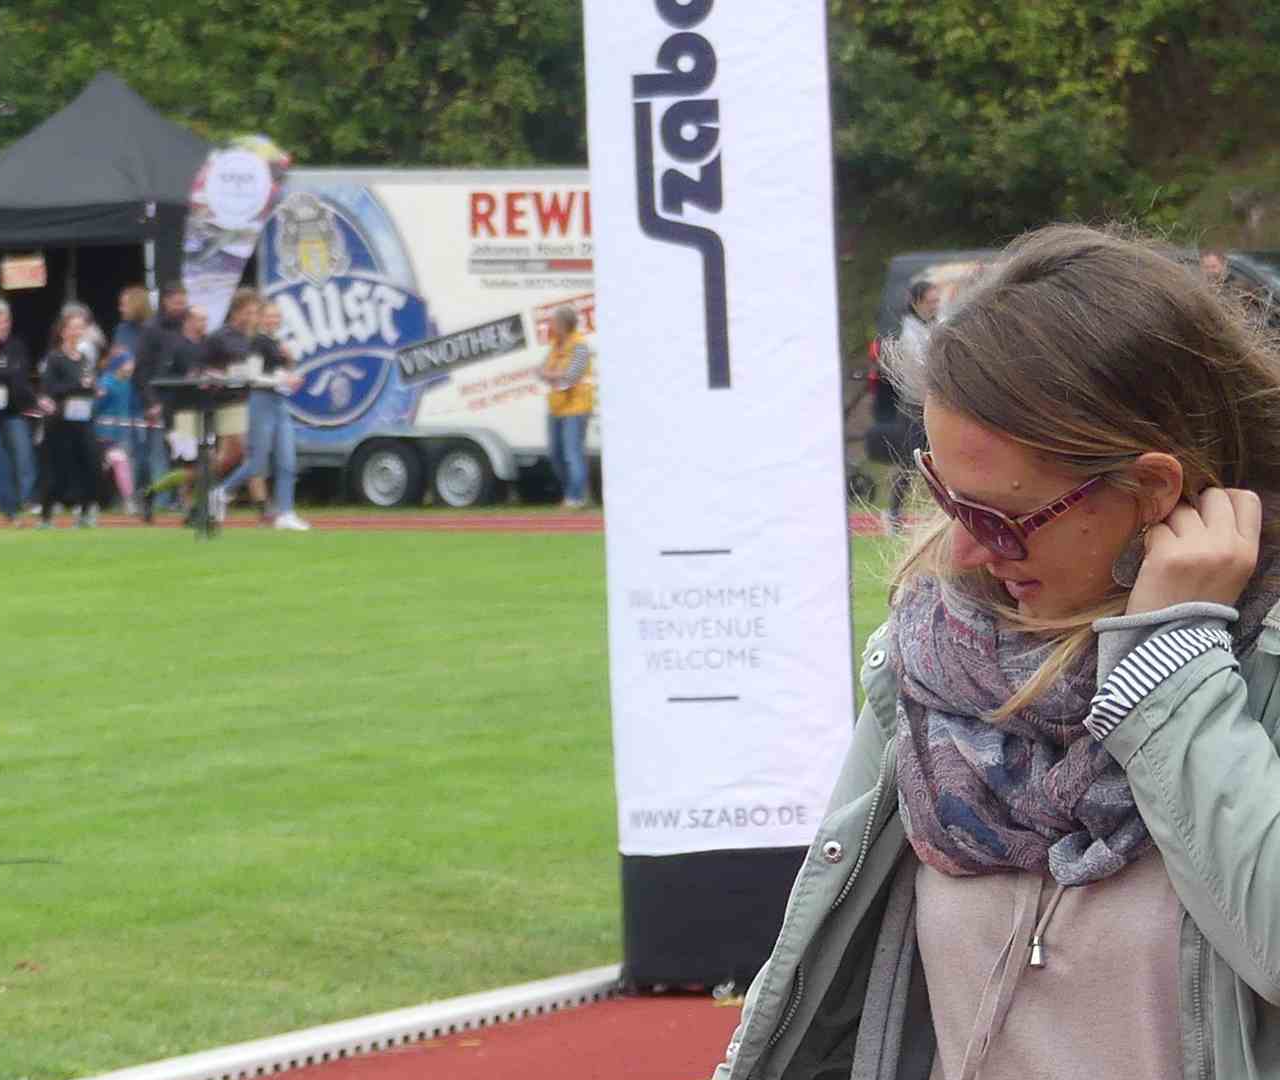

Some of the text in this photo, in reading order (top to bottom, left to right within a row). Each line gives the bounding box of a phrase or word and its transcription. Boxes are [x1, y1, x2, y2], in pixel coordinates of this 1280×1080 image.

[272, 279, 408, 361] AUST
[398, 321, 516, 376] VINOTHEK
[627, 585, 782, 610] WILLKOMMEN
[637, 616, 768, 641] BIENVENUE
[644, 647, 762, 672] WELCOME
[628, 804, 808, 830] WWW.SZABO.DE
